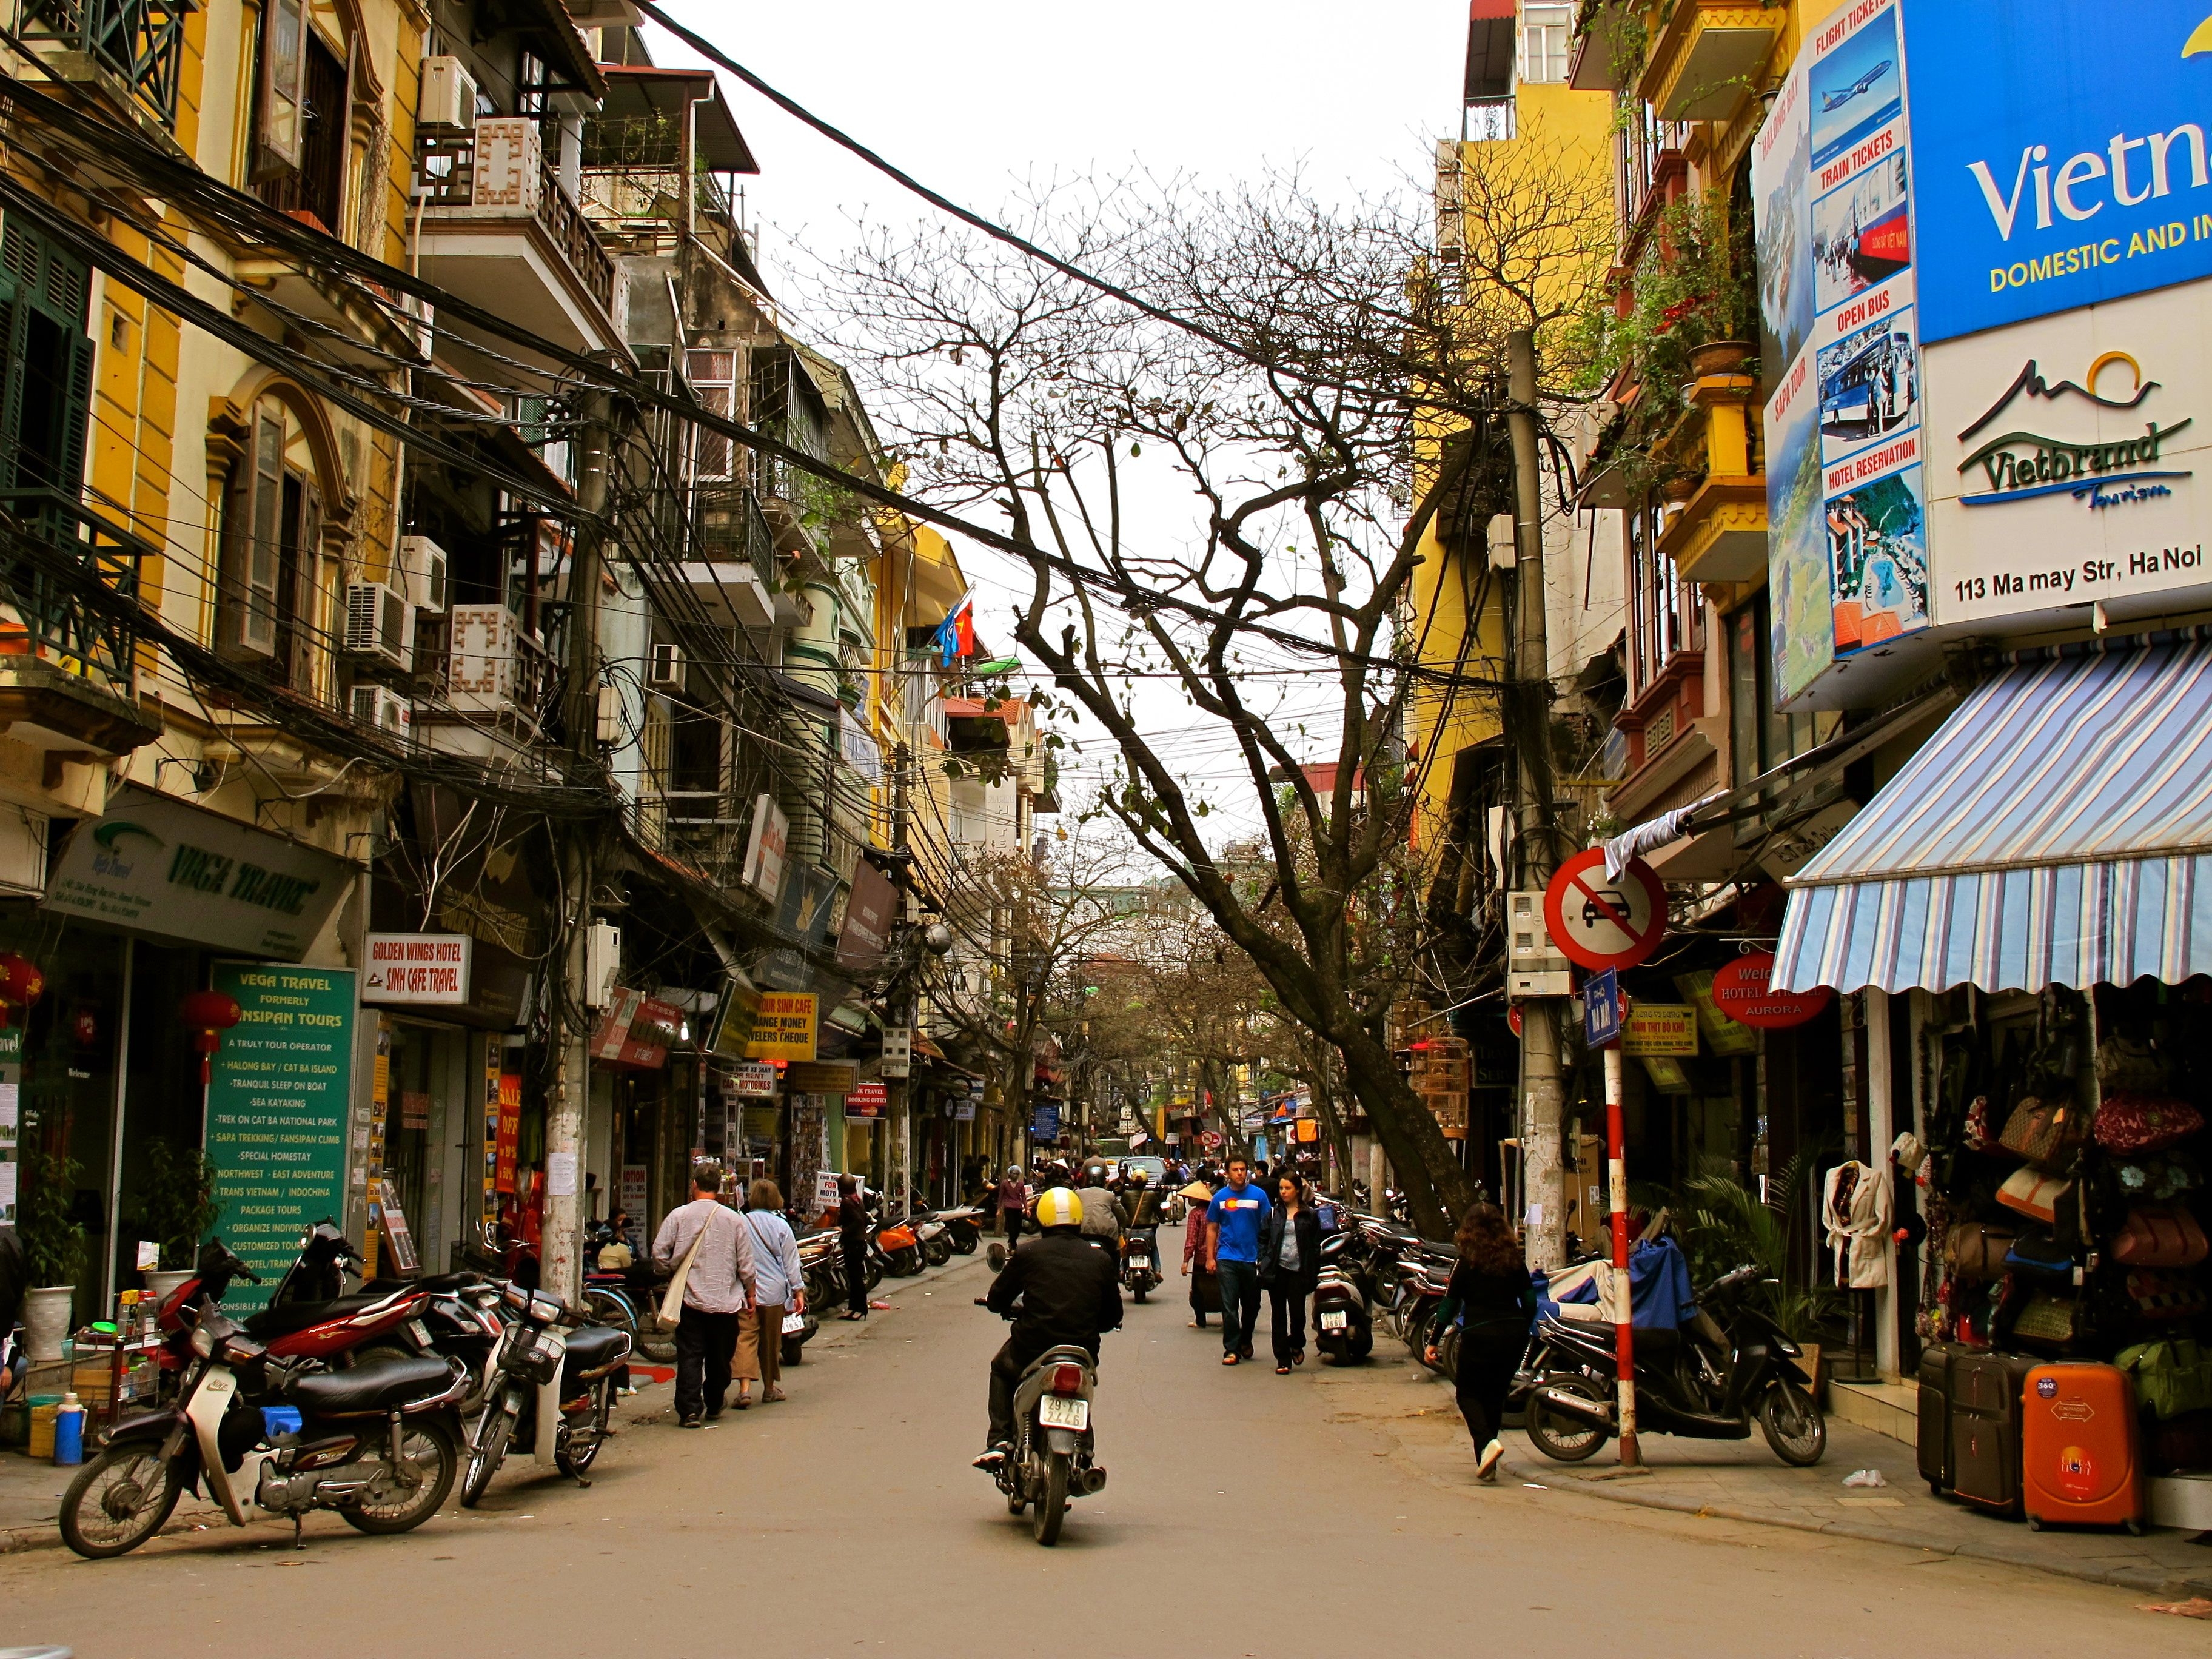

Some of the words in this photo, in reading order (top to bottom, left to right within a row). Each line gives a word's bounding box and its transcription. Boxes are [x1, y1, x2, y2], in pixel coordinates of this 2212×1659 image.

[1815, 17, 1846, 56] FLIGHT
[1761, 103, 1786, 161] HALONG
[1786, 72, 1799, 114] BAY
[1821, 157, 1849, 190] TRAIN
[1851, 129, 1893, 171] TICKETS
[1965, 123, 2212, 241] Vietn
[1991, 238, 2121, 293] DOMESTIC
[2127, 221, 2186, 259] AND
[1837, 302, 1865, 332] OPEN
[1868, 290, 1890, 318] BUS
[1775, 390, 1791, 423] SAPA
[1791, 357, 1806, 397] TOUR
[1979, 421, 2160, 491] Vietbrand
[1829, 464, 1855, 491] HOTEL
[1856, 438, 1915, 479] RESERVATION
[2071, 483, 2171, 509] Tourism
[1954, 577, 1985, 602] 113
[1992, 573, 2023, 596] Ma
[2029, 568, 2075, 591] may
[2129, 551, 2159, 575] Ha
[2163, 544, 2201, 570] Noi
[372, 942, 404, 960] GOLDEN
[407, 942, 435, 961] WINGS
[436, 943, 461, 962] HOTEL
[240, 974, 276, 988] VEGA
[281, 976, 332, 991] TRAVEL
[386, 967, 406, 993] SINH
[407, 968, 427, 994] CAFE
[429, 968, 458, 994] TRAVEL
[1721, 987, 1762, 999] HOTEL
[260, 994, 310, 1007] FORMERLY
[795, 999, 812, 1014] CAFE
[1745, 1005, 1802, 1016] AURORA
[298, 1013, 342, 1027] TOURS
[780, 1017, 806, 1028] MONEY
[780, 1032, 809, 1043] CHEQUE
[265, 1041, 287, 1049] TOUR
[289, 1042, 332, 1051] OPERATOR
[227, 1062, 260, 1071] HALONG
[261, 1062, 276, 1071] BAY
[284, 1064, 298, 1072] CAT
[300, 1064, 309, 1073] BA
[311, 1065, 337, 1074] ISLAND
[272, 1081, 292, 1090] SLEEP
[294, 1082, 305, 1090] ON
[307, 1082, 327, 1091] BOAT
[739, 1080, 771, 1090] MOTOBIKES
[268, 1099, 306, 1108] KAYAKING
[238, 1115, 249, 1124] ON
[252, 1116, 266, 1124] CAT
[267, 1116, 278, 1125] BA
[280, 1117, 316, 1126] NATIONAL
[317, 1118, 337, 1127] PARK
[503, 1116, 518, 1134] OFF
[216, 1133, 236, 1142] SAPA
[280, 1134, 317, 1144] FANSIPAN
[318, 1136, 340, 1144] CLIMB
[271, 1152, 311, 1161] HOMESTAY
[217, 1170, 264, 1179] NORTHWEST
[273, 1170, 291, 1179] EAST
[292, 1171, 335, 1179] ADVENTURE
[220, 1187, 244, 1196] TRANS
[246, 1188, 279, 1196] VIETNAM
[289, 1188, 330, 1197] INDOCHINA
[241, 1205, 275, 1215] PACKAGE
[277, 1205, 302, 1215] TOURS
[233, 1224, 270, 1233] ORGANIZE
[273, 1224, 308, 1233] INDIVIDU
[232, 1242, 280, 1251] CUSTOMIZED
[213, 1379, 229, 1389] NIKE
